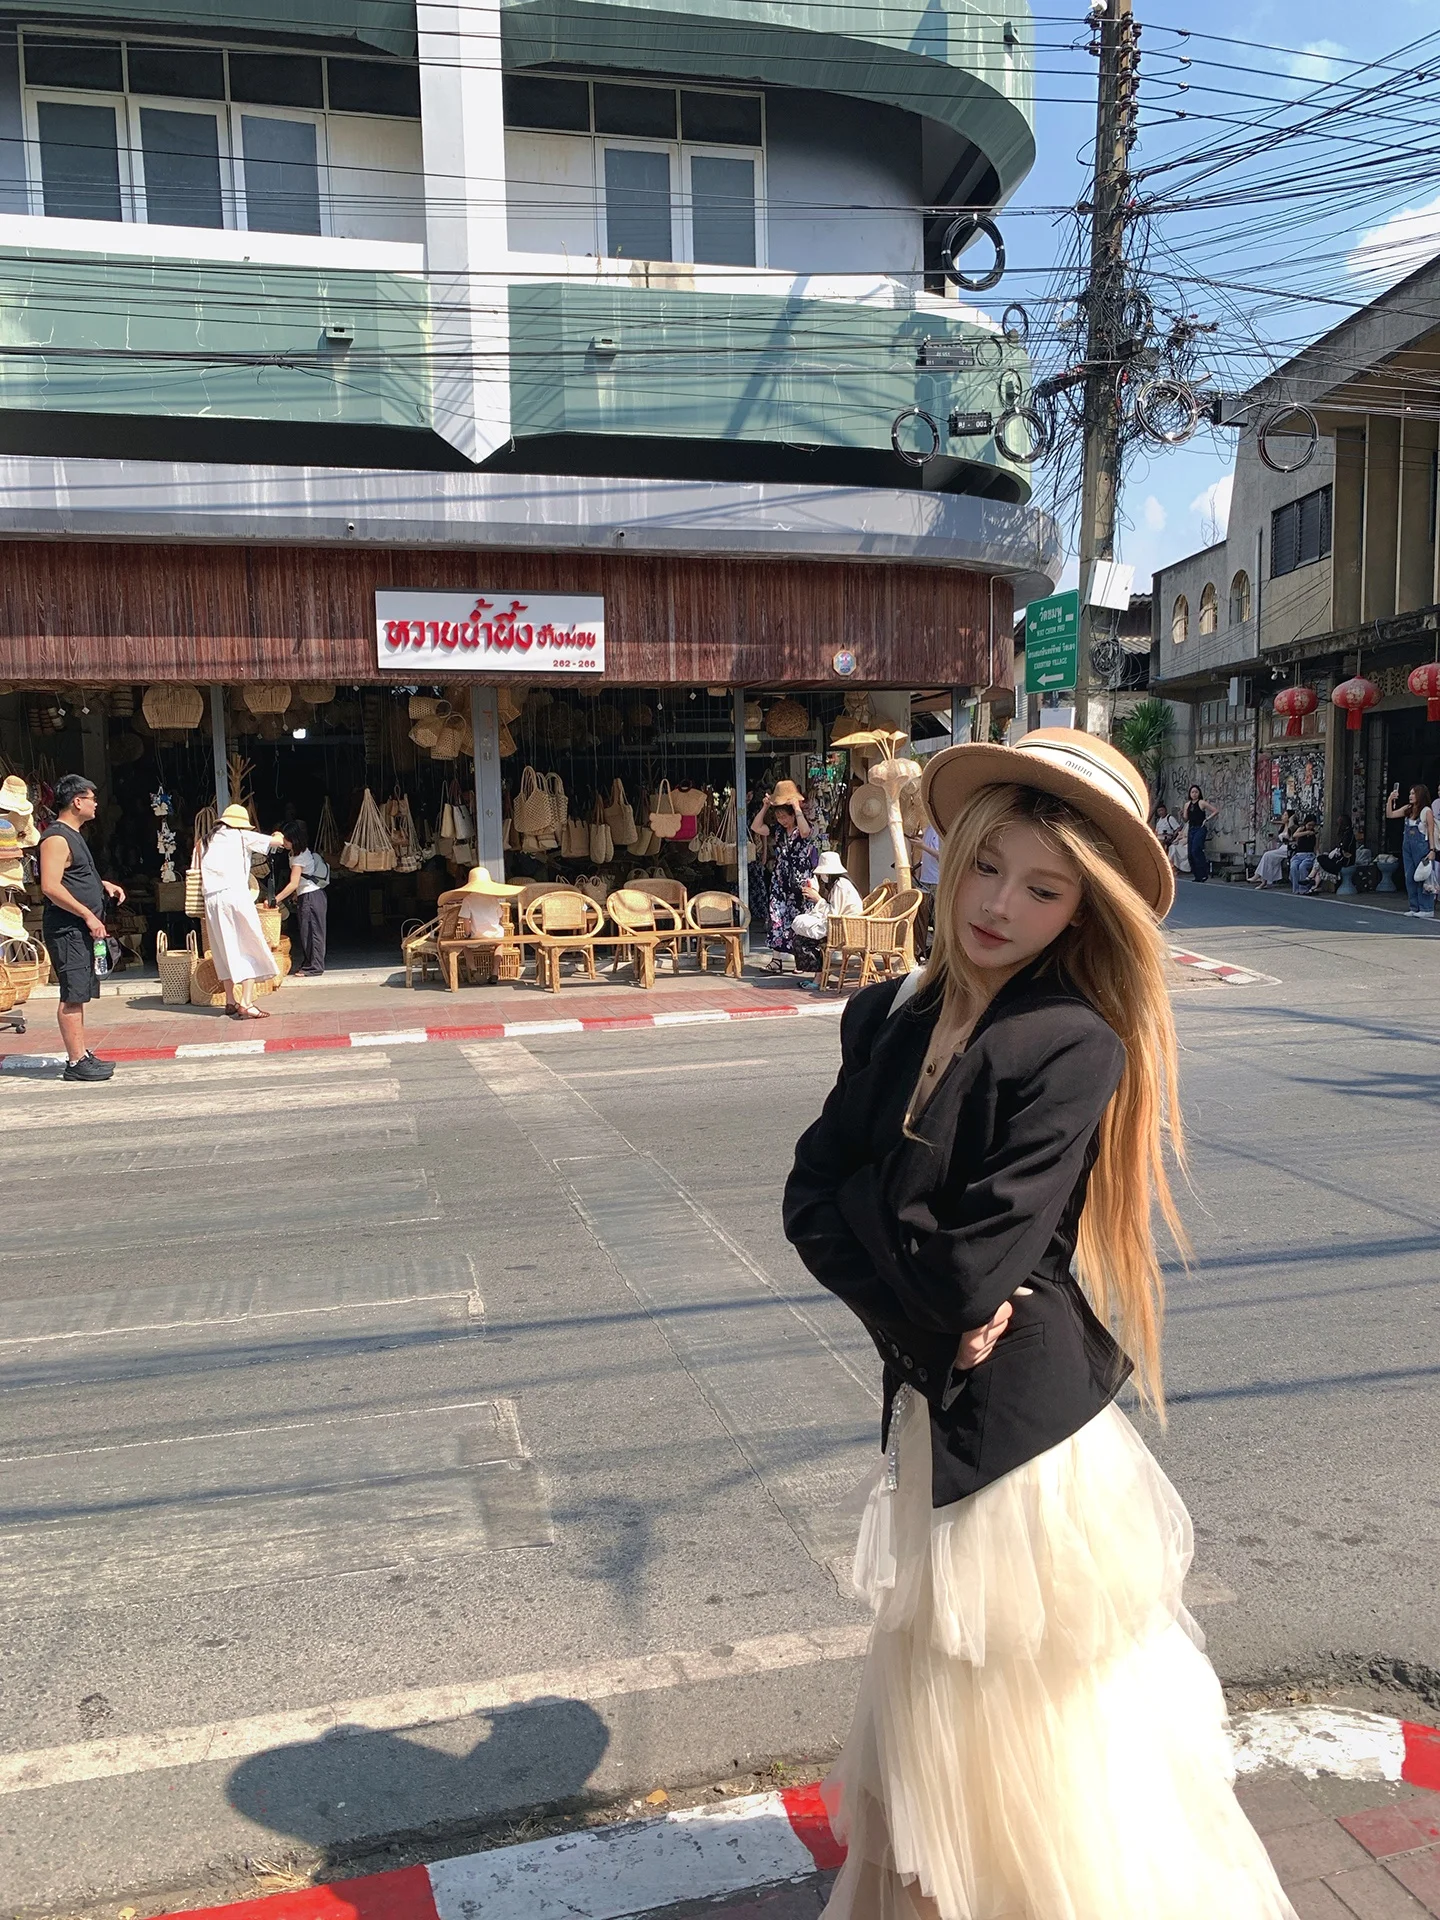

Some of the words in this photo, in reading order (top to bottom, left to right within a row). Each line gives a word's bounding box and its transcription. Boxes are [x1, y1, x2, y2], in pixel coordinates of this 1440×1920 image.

[385, 597, 534, 650] หวายน้ำผึ้ง
